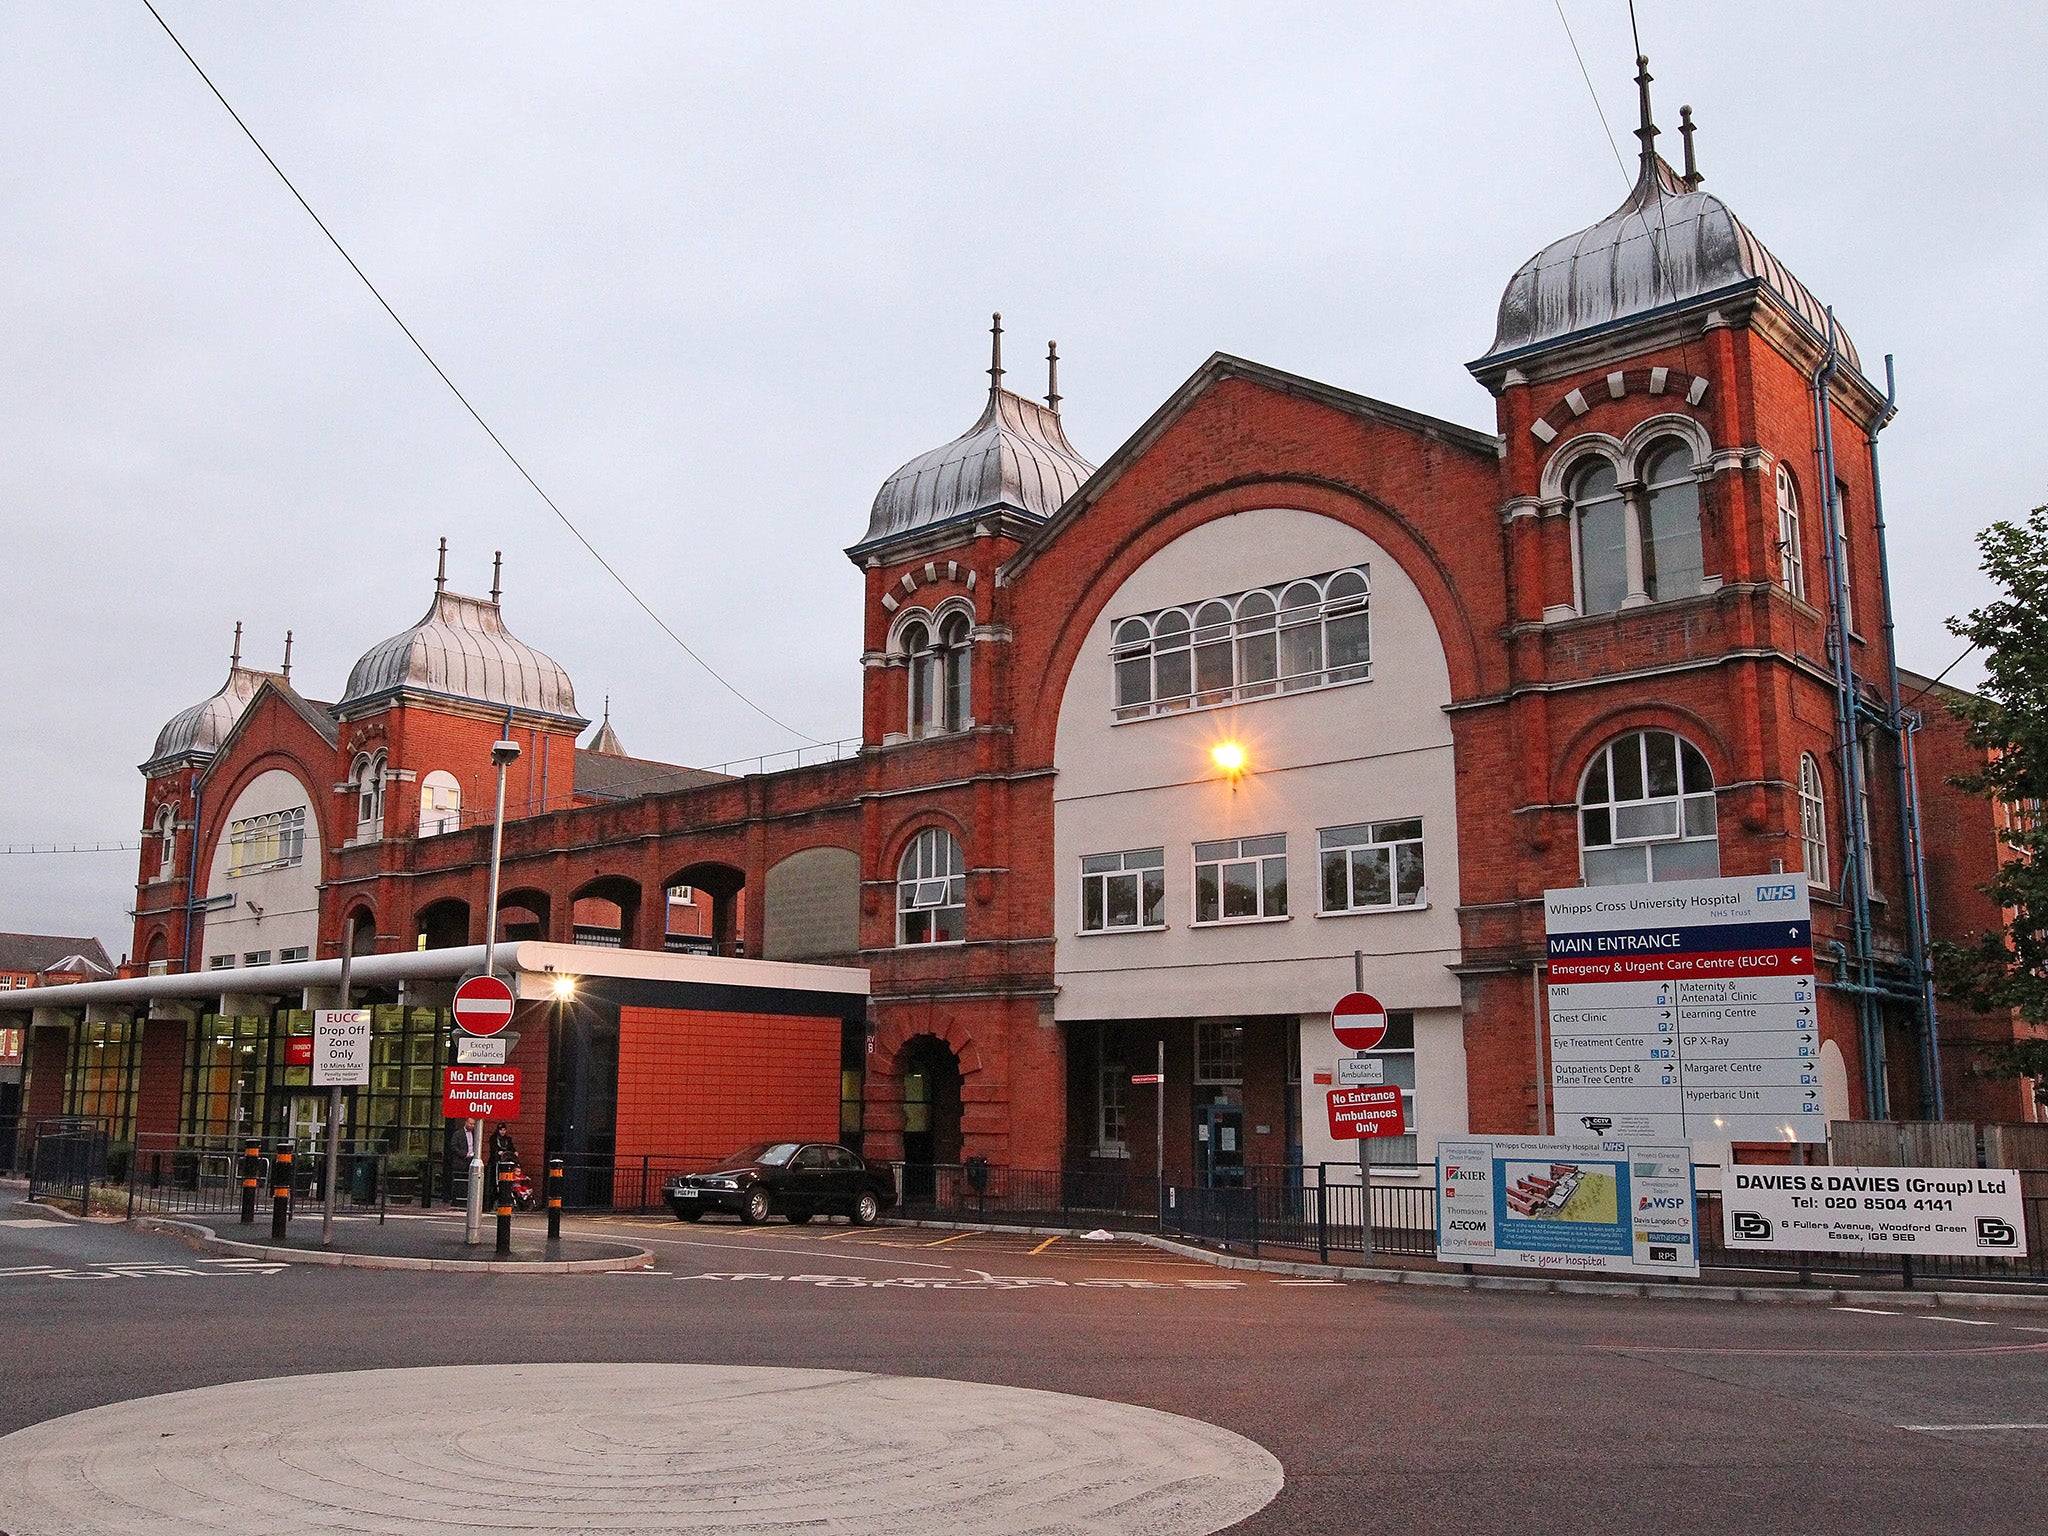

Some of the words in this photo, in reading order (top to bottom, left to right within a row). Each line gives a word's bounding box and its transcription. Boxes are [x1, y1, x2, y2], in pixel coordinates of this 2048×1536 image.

[1758, 886, 1794, 900] NHS
[1550, 904, 1592, 915] Whipps
[1596, 901, 1626, 912] Cross
[1630, 898, 1687, 910] University
[1691, 893, 1740, 907] Hospital
[1551, 938, 1592, 953] MAIN
[1599, 934, 1680, 950] ENTRANCE
[1552, 963, 1610, 976] Emergency
[1614, 963, 1622, 972] &
[1626, 960, 1664, 973] Urgent
[1667, 960, 1692, 969] Care
[1696, 958, 1735, 968] Centre
[1738, 955, 1778, 969] (EUCC)
[1680, 982, 1725, 992] Maternity
[1729, 982, 1736, 990] &
[1682, 992, 1727, 1002] Antenatal
[1732, 992, 1757, 1000] Clinic
[327, 1014, 359, 1023] EUCC
[1553, 1014, 1578, 1022] Chest
[1582, 1013, 1606, 1021] Clinic
[1682, 1010, 1721, 1020] Learning
[1725, 1009, 1756, 1017] Centre
[320, 1027, 344, 1036] Drop
[348, 1026, 365, 1034] Off
[1554, 1039, 1568, 1048] Eye
[1570, 1038, 1613, 1047] Treatment
[1683, 1037, 1697, 1045] GP
[1700, 1036, 1729, 1046] X-Ray
[330, 1050, 353, 1060] Only
[1556, 1065, 1607, 1075] Outpatients
[1610, 1065, 1631, 1074] Dept
[1685, 1063, 1727, 1074] Margaret
[1730, 1063, 1761, 1072] Centre
[450, 1071, 463, 1080] No
[467, 1072, 514, 1082] Entrance
[449, 1089, 514, 1100] Ambulances
[1332, 1094, 1345, 1104] No
[1348, 1092, 1395, 1102] Entrance
[1686, 1091, 1736, 1101] Hyperbaric
[1740, 1090, 1759, 1099] Unit
[469, 1102, 492, 1114] Only
[1335, 1109, 1397, 1122] Ambulances
[1356, 1122, 1378, 1133] Only
[1539, 1143, 1570, 1151] University
[1603, 1142, 1624, 1150] NHS
[1460, 1172, 1486, 1180] KIER
[1736, 1175, 1806, 1191] DAVIES
[1811, 1176, 1823, 1190] &
[1828, 1177, 1899, 1192] DAVIES
[1906, 1177, 1973, 1195] (Group)
[1978, 1179, 2005, 1194] Ltd
[1653, 1197, 1684, 1208] WSP
[1792, 1197, 1818, 1208] Tel:
[1825, 1197, 1857, 1210] 020
[1864, 1198, 1907, 1211] 8504
[1913, 1199, 1953, 1212] 4141
[1447, 1207, 1487, 1215] Thomasons
[1449, 1221, 1486, 1230] AECOM
[1781, 1220, 1789, 1228] 6
[1793, 1221, 1829, 1230] Fullers
[1834, 1221, 1873, 1232] Avenue,
[1879, 1222, 1931, 1232] Woodford
[1935, 1224, 1967, 1233] Green
[1828, 1231, 1863, 1242] Essex,
[1868, 1232, 1889, 1241] IG8
[1892, 1232, 1916, 1242] 9EB
[1520, 1253, 1535, 1262] It's
[1538, 1256, 1562, 1267] your
[1565, 1255, 1606, 1268] hospital
